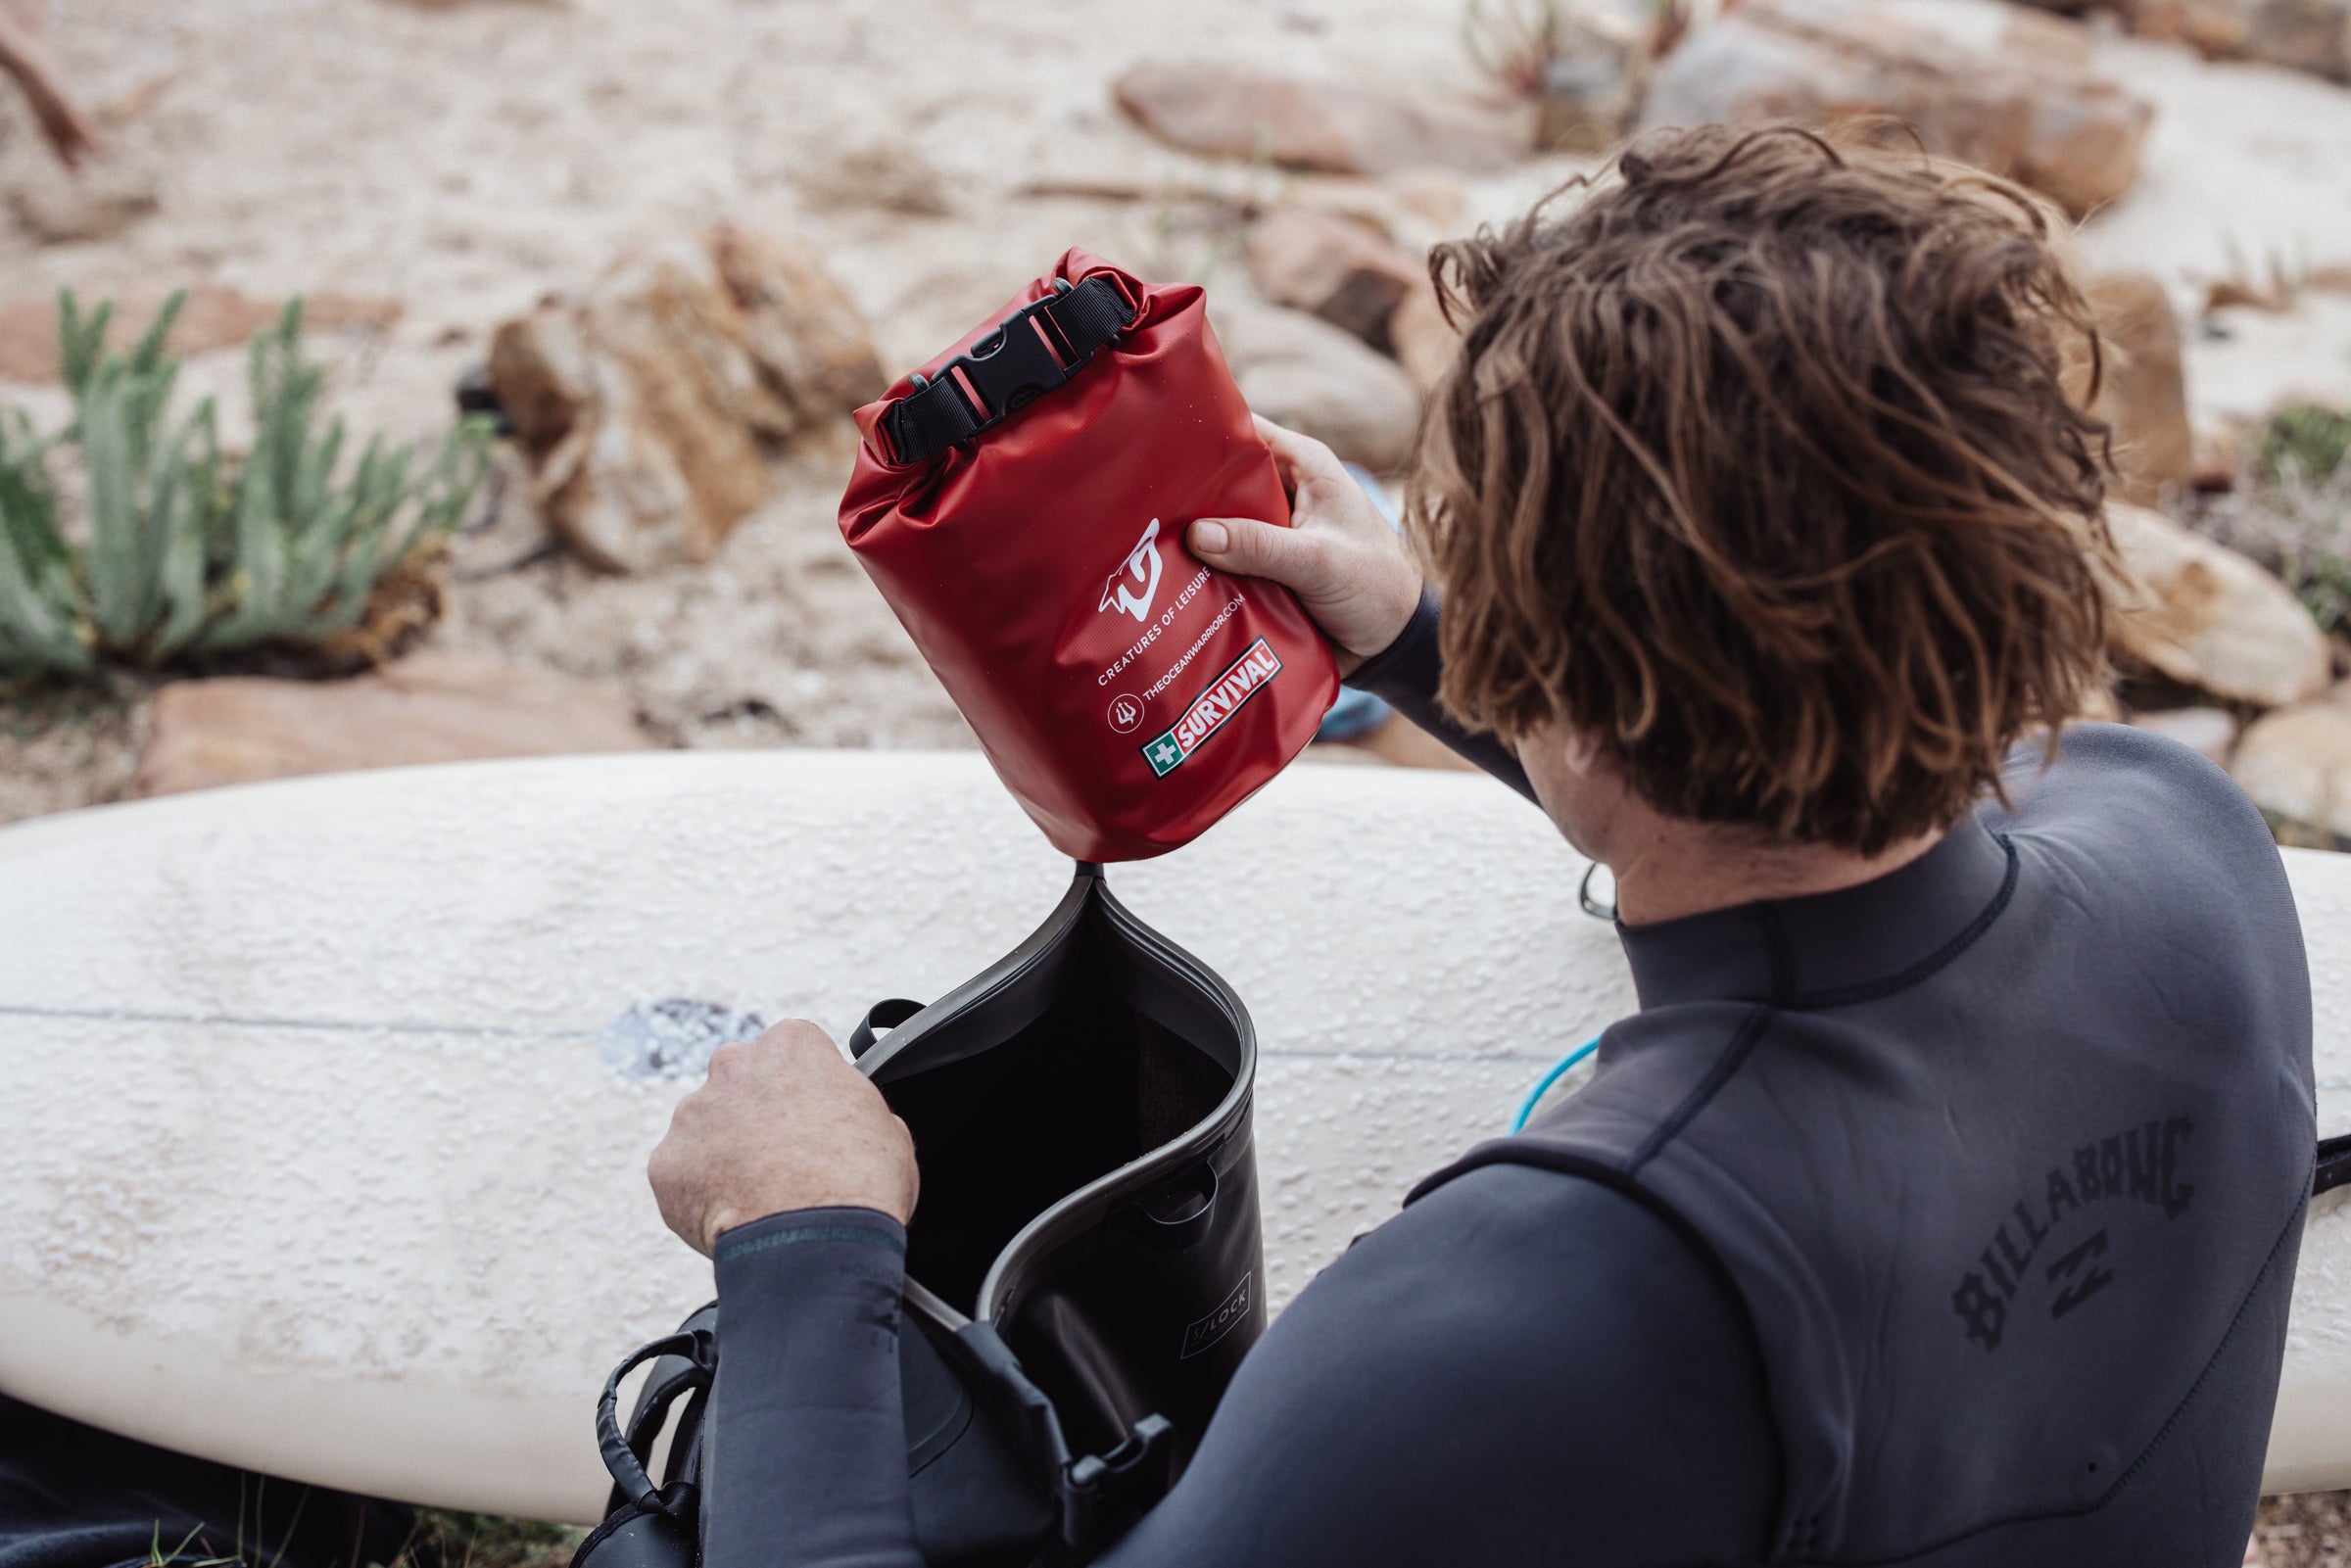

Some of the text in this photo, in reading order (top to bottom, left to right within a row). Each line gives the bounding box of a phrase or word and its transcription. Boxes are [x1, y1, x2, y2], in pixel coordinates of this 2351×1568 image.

[1097, 566, 1212, 687] CREATURES OF LEISURE
[1142, 593, 1247, 702] THEOCEANWARRIOR.COM
[1177, 650, 1275, 748] SURVIVAL
[1953, 1117, 2194, 1353] BILLABONG
